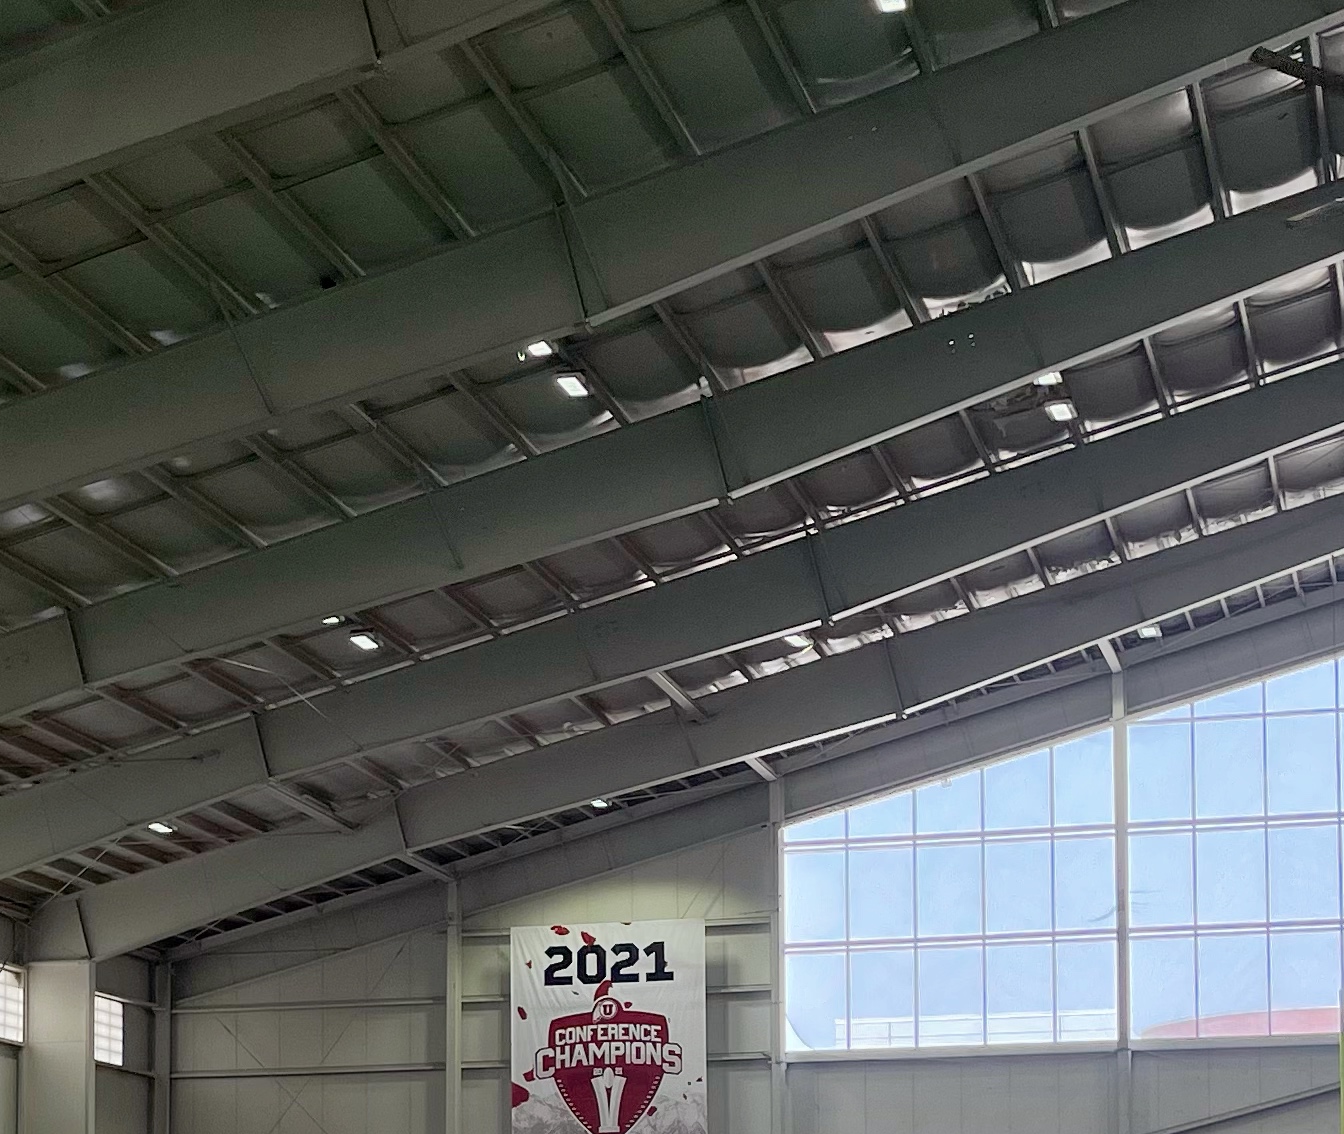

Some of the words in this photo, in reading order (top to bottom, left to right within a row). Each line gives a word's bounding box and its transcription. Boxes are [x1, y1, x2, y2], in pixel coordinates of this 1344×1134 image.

[544, 941, 675, 986] 2021
[555, 1023, 662, 1046] CONFERENCE
[535, 1042, 683, 1080] CHAMPIONS
